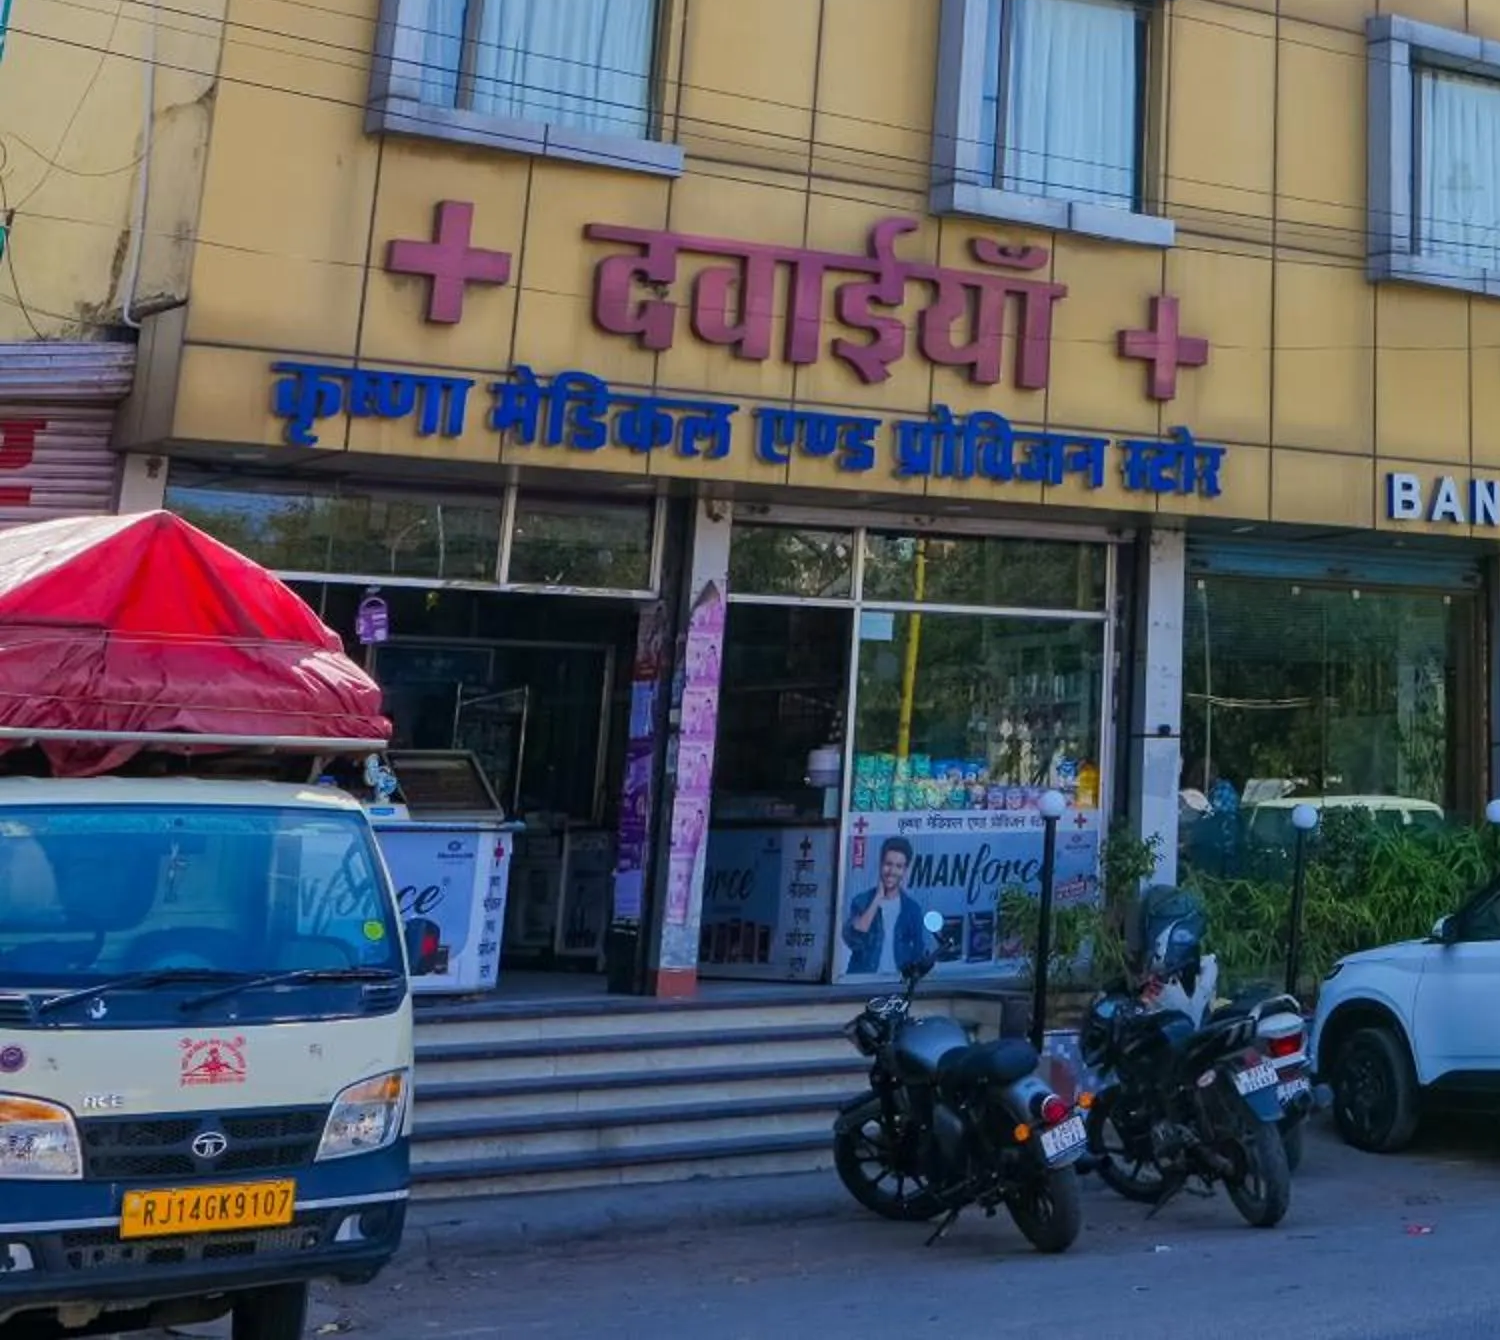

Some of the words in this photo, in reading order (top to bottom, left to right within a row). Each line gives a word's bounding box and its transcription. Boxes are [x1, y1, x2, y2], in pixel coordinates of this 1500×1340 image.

[583, 217, 1067, 391] दवाईयाँ
[271, 361, 474, 446] कृष्णा
[487, 363, 738, 459] मेडिकल
[753, 406, 882, 471] एण्ड
[891, 403, 1110, 489] प्रोविजन
[1117, 426, 1226, 498] स्टोर
[908, 842, 1048, 906] MANforc
[83, 1094, 125, 1110] ACE
[143, 1188, 290, 1227] RJ14GK9107
